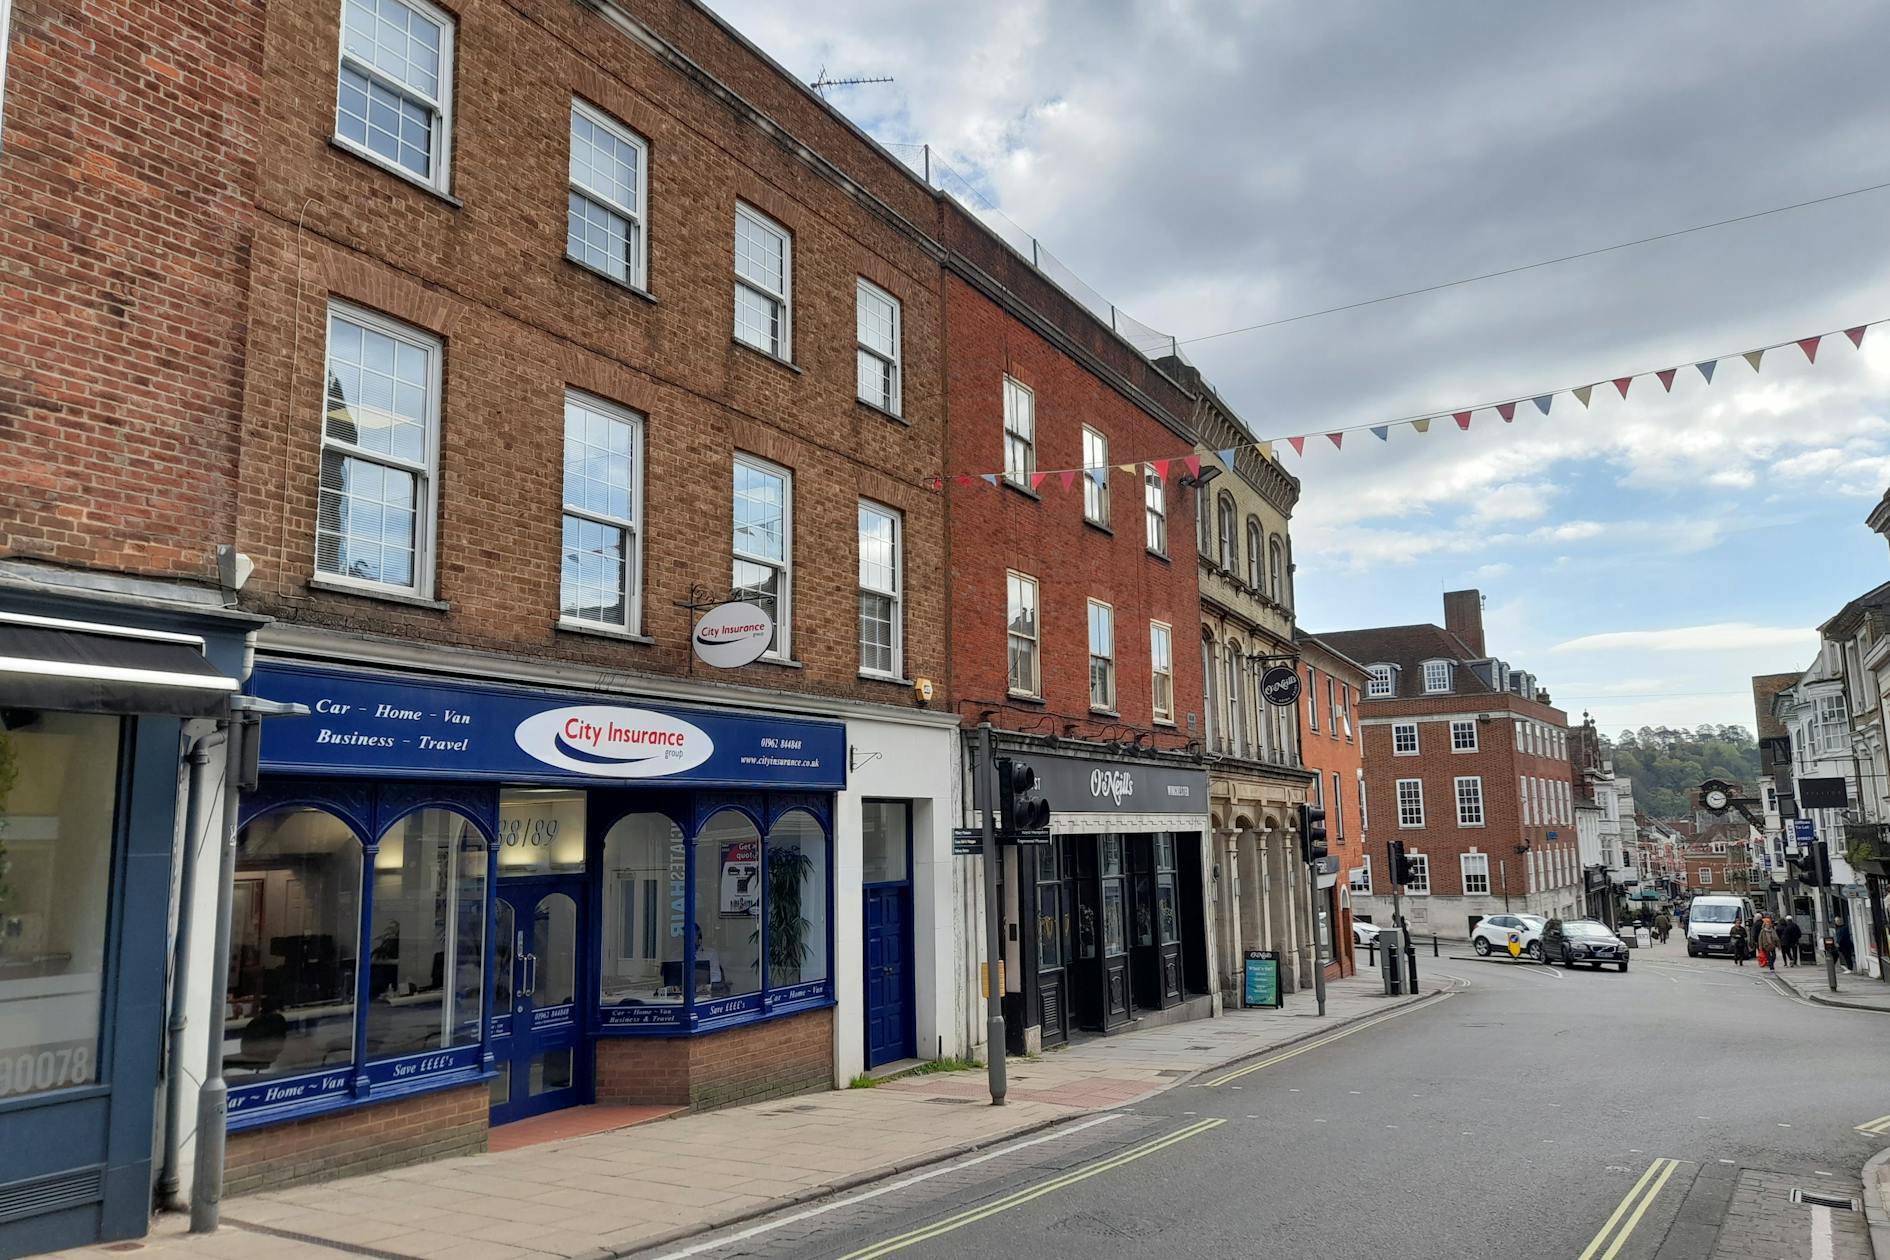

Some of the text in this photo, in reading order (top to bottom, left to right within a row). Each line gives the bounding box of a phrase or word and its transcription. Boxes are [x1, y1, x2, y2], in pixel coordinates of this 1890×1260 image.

[701, 623, 765, 638] City Insurance
[315, 699, 350, 715] Car
[375, 703, 422, 721] Home
[443, 709, 471, 724] Van
[316, 728, 394, 747] Business
[418, 735, 469, 751] Travel
[564, 717, 684, 747] City Insurance
[760, 738, 778, 749] 01962
[664, 748, 684, 760] group
[740, 755, 820, 768] www.cityinsurance.co.uk
[1031, 777, 1041, 790] ST
[1090, 768, 1134, 806] O'Neill's
[789, 989, 806, 1000] Home
[812, 986, 823, 994] Van
[709, 1004, 724, 1015] Save
[393, 1056, 454, 1077] Save ££££'s
[227, 1094, 245, 1109] ar
[265, 1085, 304, 1102] Home
[322, 1076, 345, 1090] Van
